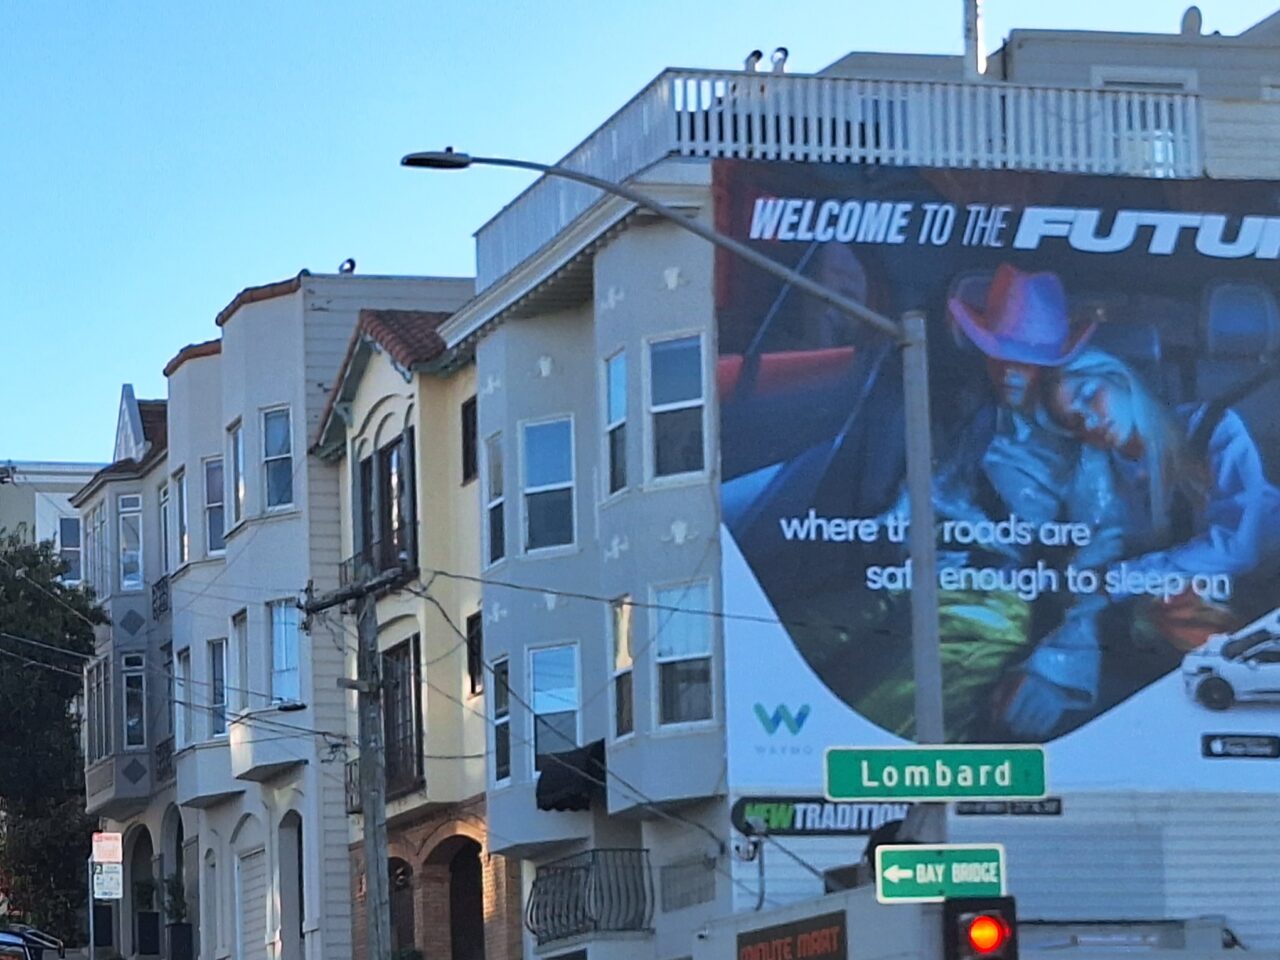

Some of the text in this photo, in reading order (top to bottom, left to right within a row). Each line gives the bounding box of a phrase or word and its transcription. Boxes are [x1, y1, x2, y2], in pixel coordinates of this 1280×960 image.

[749, 198, 913, 243] WELCOME
[919, 203, 956, 246] TO
[962, 203, 1013, 248] THE
[780, 508, 878, 542] where
[943, 513, 1032, 545] roads
[1039, 520, 1091, 547] are
[866, 559, 1231, 603] saf enough to sleep on
[861, 759, 1013, 788] Lombard
[916, 861, 999, 884] BAY BRIDGE
[797, 925, 842, 959] MART
